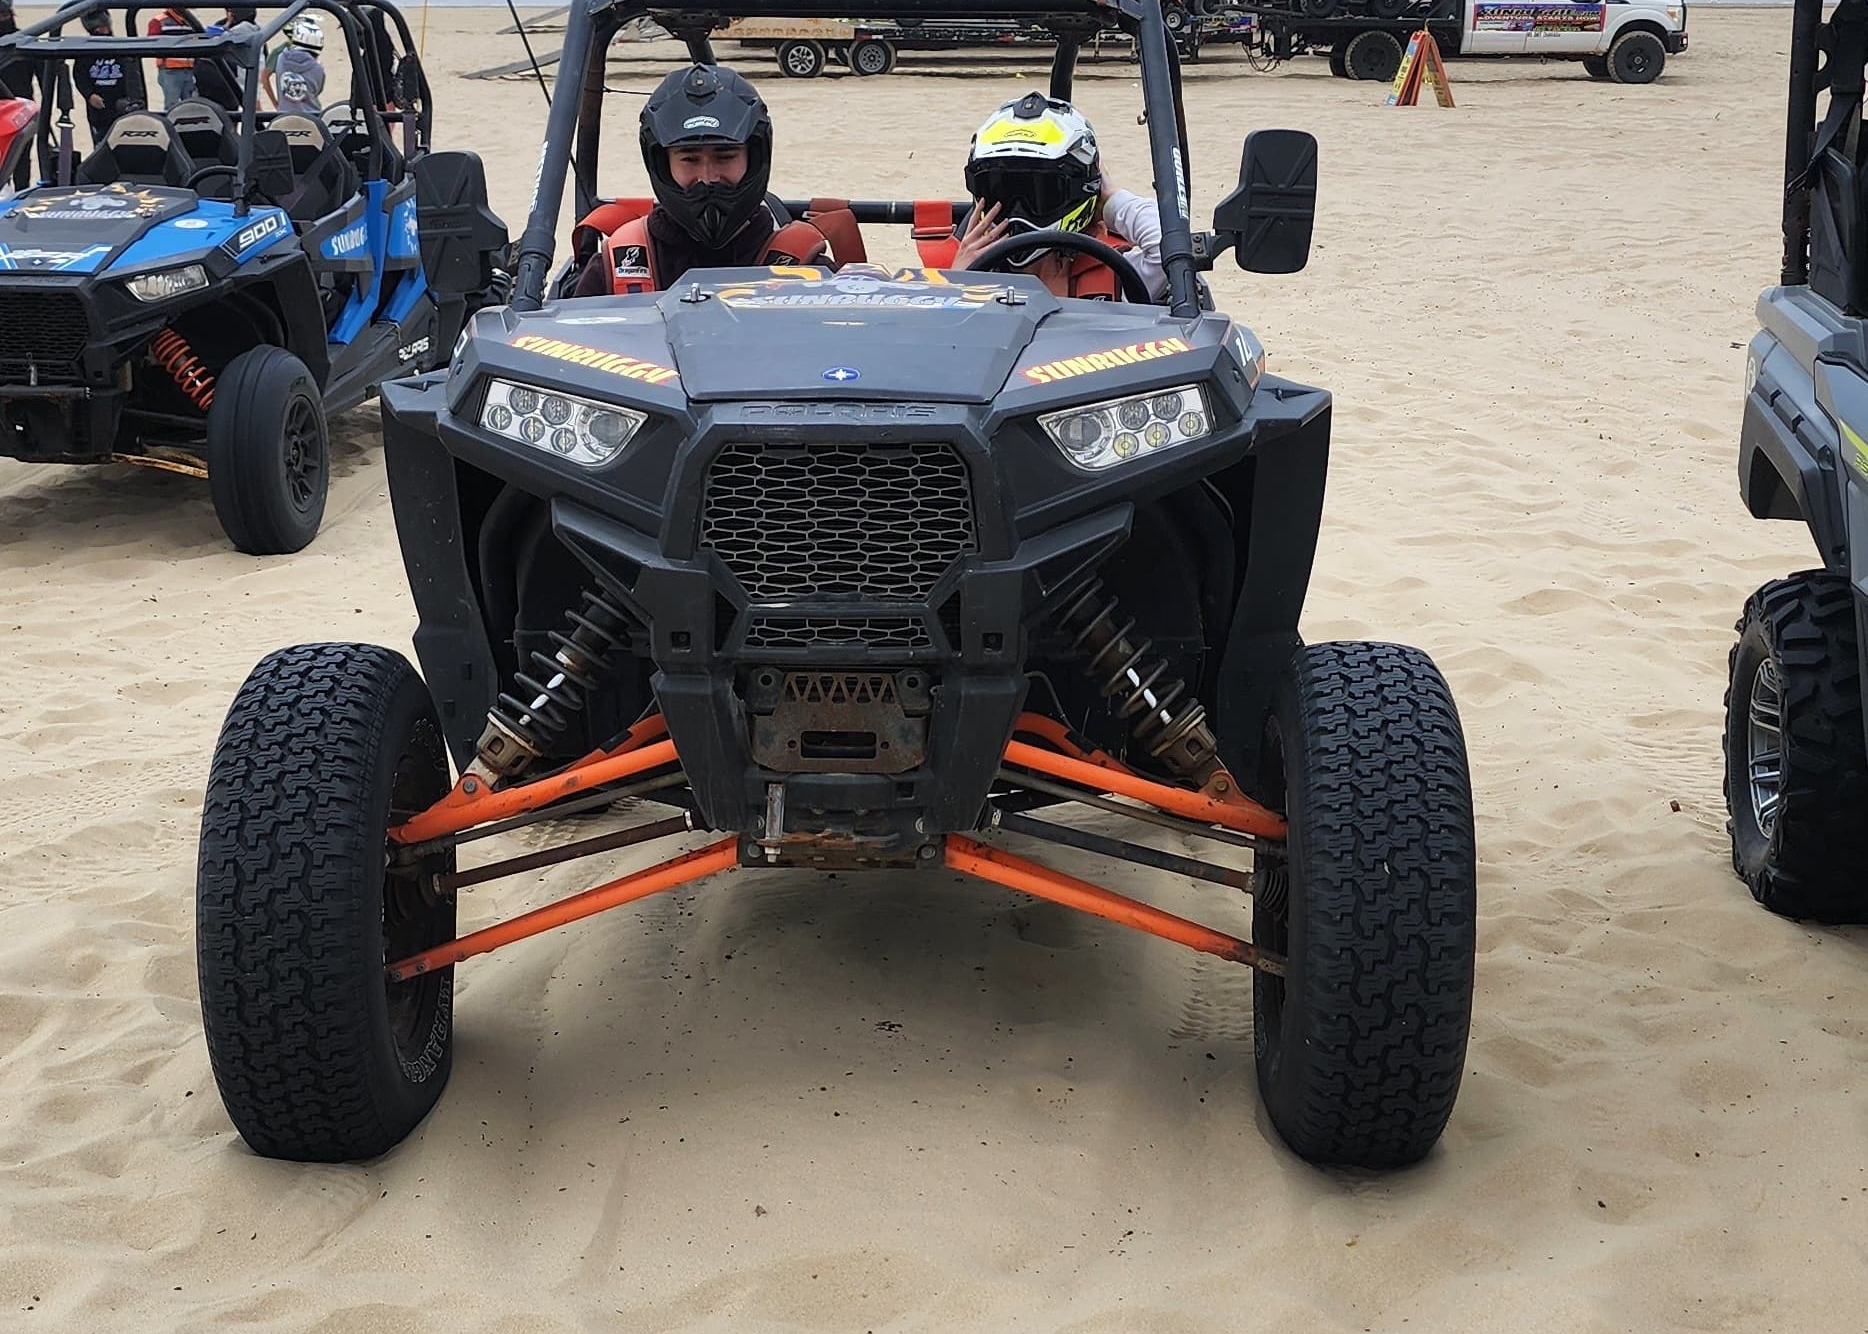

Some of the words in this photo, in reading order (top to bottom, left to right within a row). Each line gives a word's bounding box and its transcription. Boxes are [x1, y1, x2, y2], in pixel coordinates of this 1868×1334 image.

[119, 130, 159, 138] RZR
[284, 130, 311, 138] ZR
[239, 216, 278, 250] 900
[510, 334, 681, 385] SUNBUGGY
[1023, 336, 1191, 385] SUNBUGGY
[741, 403, 938, 418] POLARIS
